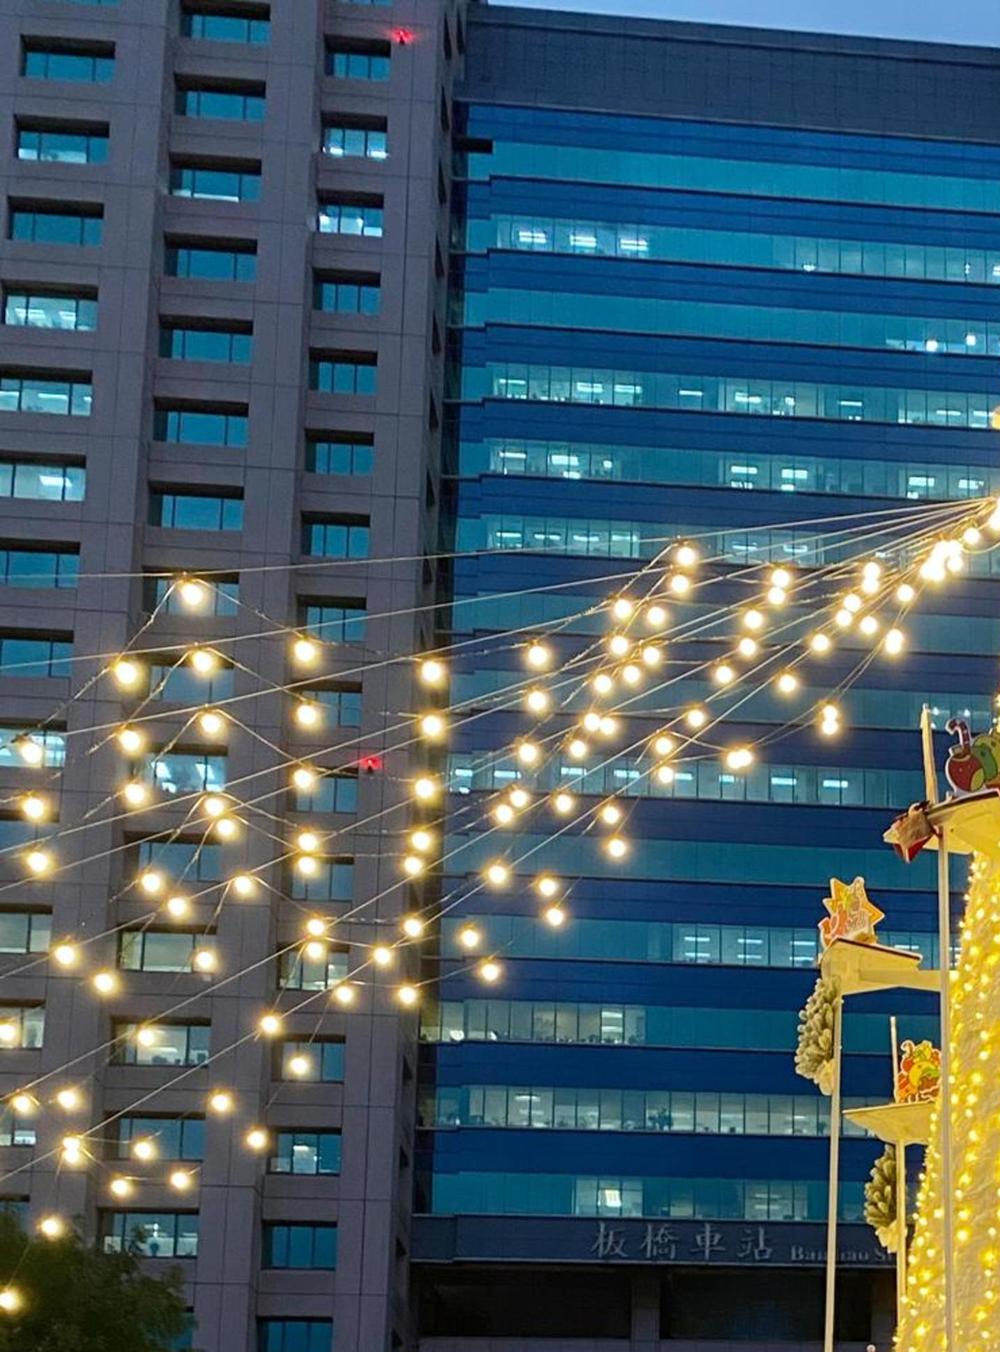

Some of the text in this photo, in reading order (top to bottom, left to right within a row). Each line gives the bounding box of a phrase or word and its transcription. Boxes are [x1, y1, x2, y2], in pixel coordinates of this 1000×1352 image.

[590, 1222, 774, 1261] 板橋車站
[790, 1245, 869, 1261] Baniao
